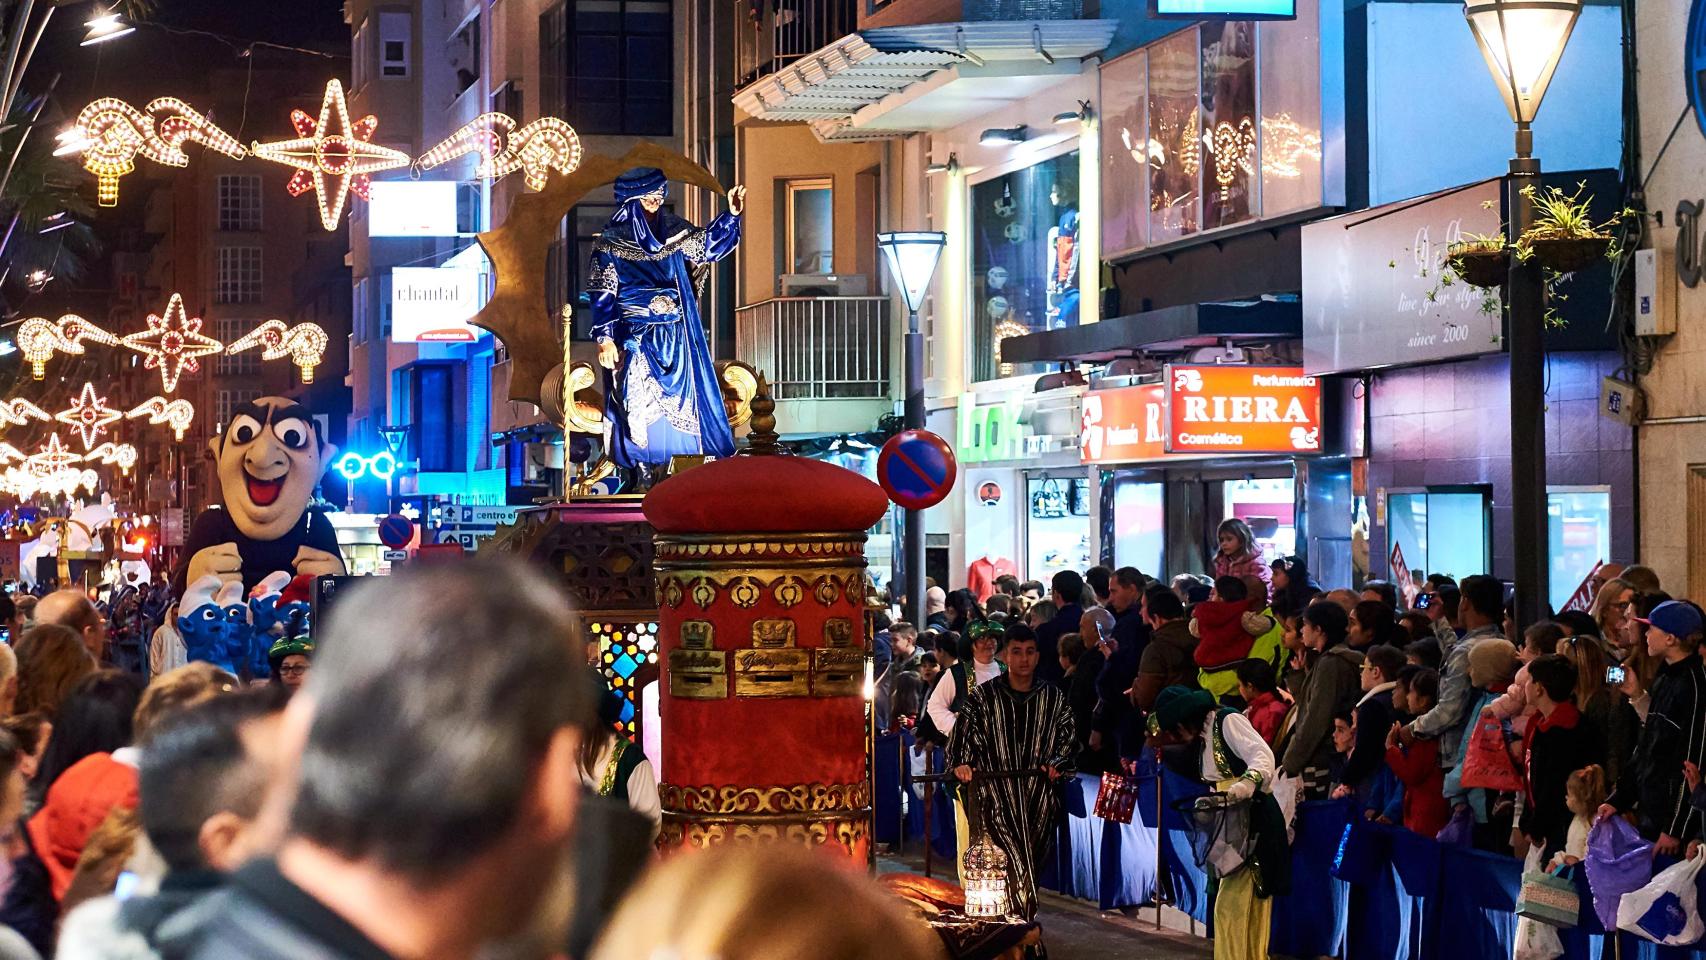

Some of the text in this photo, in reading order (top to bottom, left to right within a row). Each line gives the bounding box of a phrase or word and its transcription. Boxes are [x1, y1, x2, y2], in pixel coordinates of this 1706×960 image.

[398, 284, 459, 301] chantal
[1397, 292, 1417, 312] live
[1407, 324, 1469, 347] since 2000
[1183, 396, 1310, 423] RIERA
[1178, 432, 1243, 445] Cosmética
